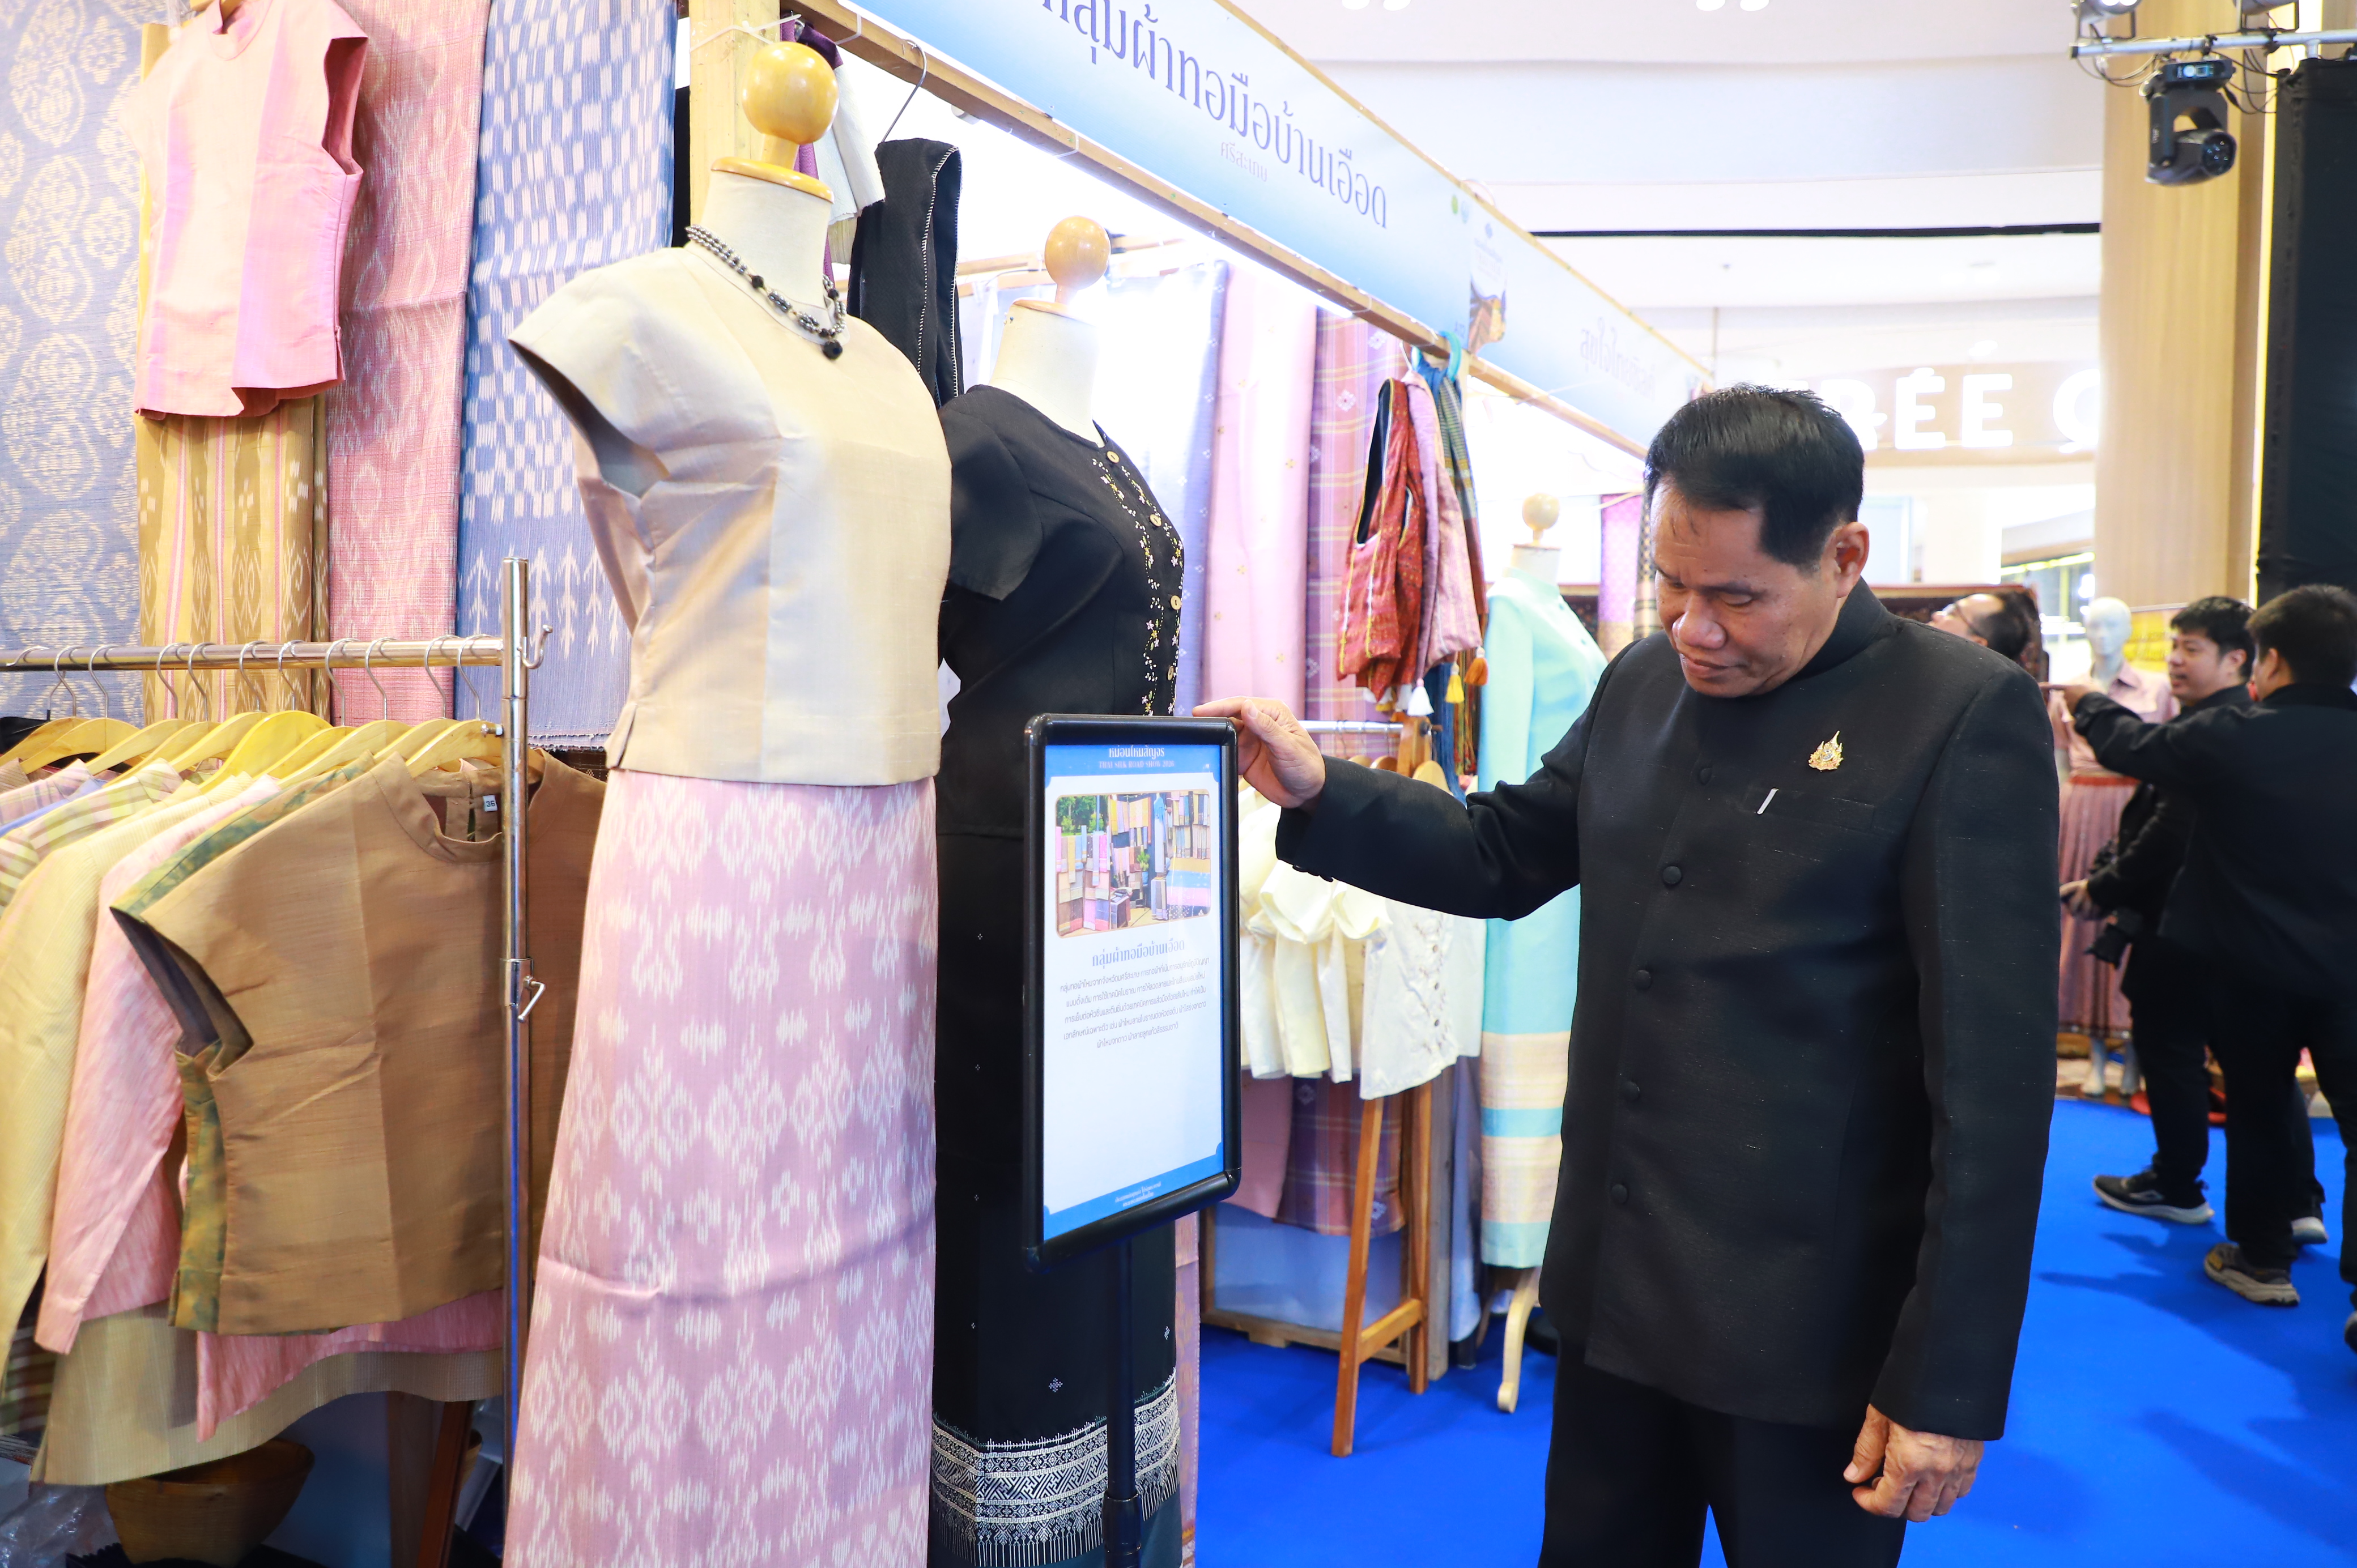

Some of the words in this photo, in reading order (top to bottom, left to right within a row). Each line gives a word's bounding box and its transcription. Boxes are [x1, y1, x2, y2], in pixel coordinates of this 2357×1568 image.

[1043, 0, 1386, 229] ลุมผ้าทอมือบ้านเอือด
[1220, 142, 1267, 182] ศรีสะเกษ
[1109, 745, 1165, 760] หม่อนไหมสัญจร
[1092, 938, 1185, 969] กลุ่มผ้าทอมือบ้านเอือด
[1066, 994, 1092, 1007] แบบดั้งเดิม
[1093, 987, 1136, 1002] การใช้เทคนิคโบราณ
[1063, 1023, 1109, 1040] เอกลักษณ์เฉพาะตัว
